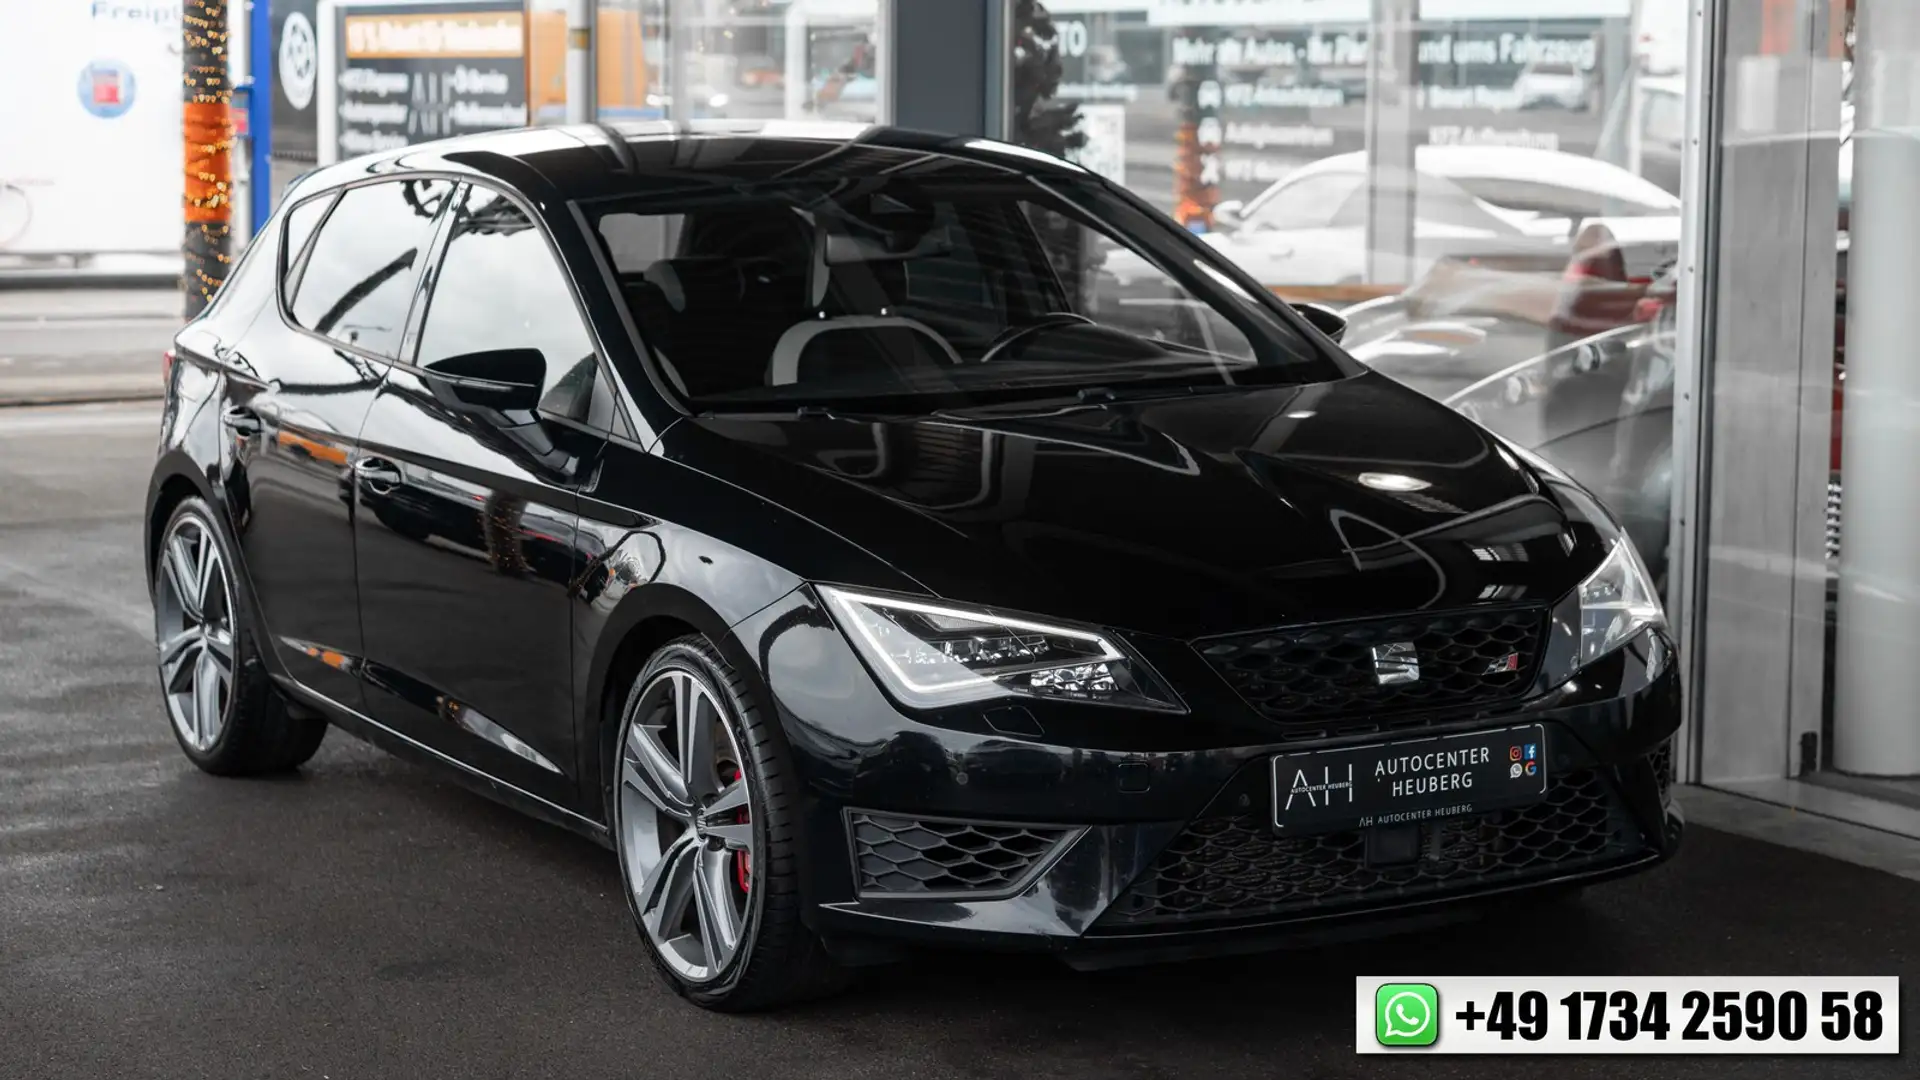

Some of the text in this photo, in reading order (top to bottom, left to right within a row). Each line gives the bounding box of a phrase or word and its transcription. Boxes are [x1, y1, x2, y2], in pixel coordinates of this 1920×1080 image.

[1375, 747, 1490, 777] AUTOCENTER
[1392, 771, 1473, 798] HEUBERG
[1378, 809, 1432, 825] AUTOCENTER
[1435, 804, 1473, 817] HEUBERG
